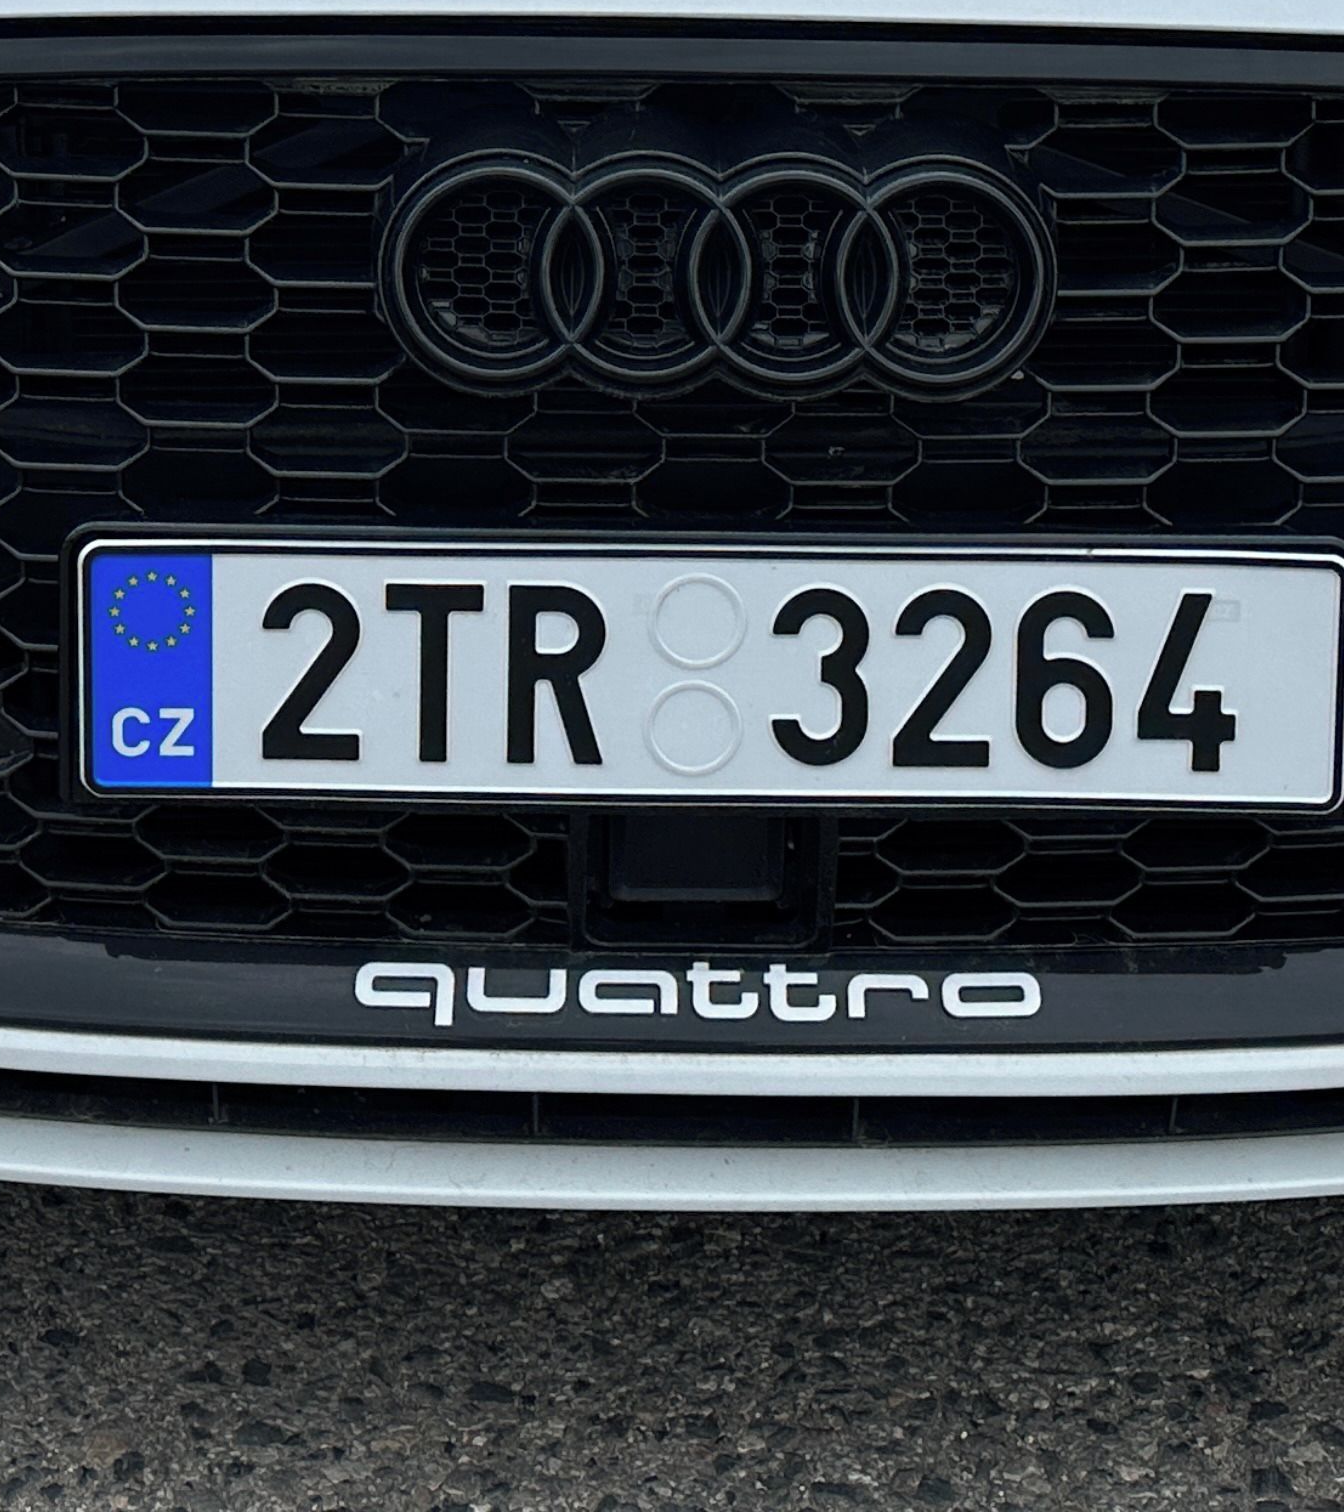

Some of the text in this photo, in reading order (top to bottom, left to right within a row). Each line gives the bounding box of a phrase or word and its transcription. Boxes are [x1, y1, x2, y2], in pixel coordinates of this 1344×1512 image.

[261, 583, 1236, 773] 2TR 3264
[112, 707, 195, 758] CZ
[355, 962, 1042, 1026] quattro
